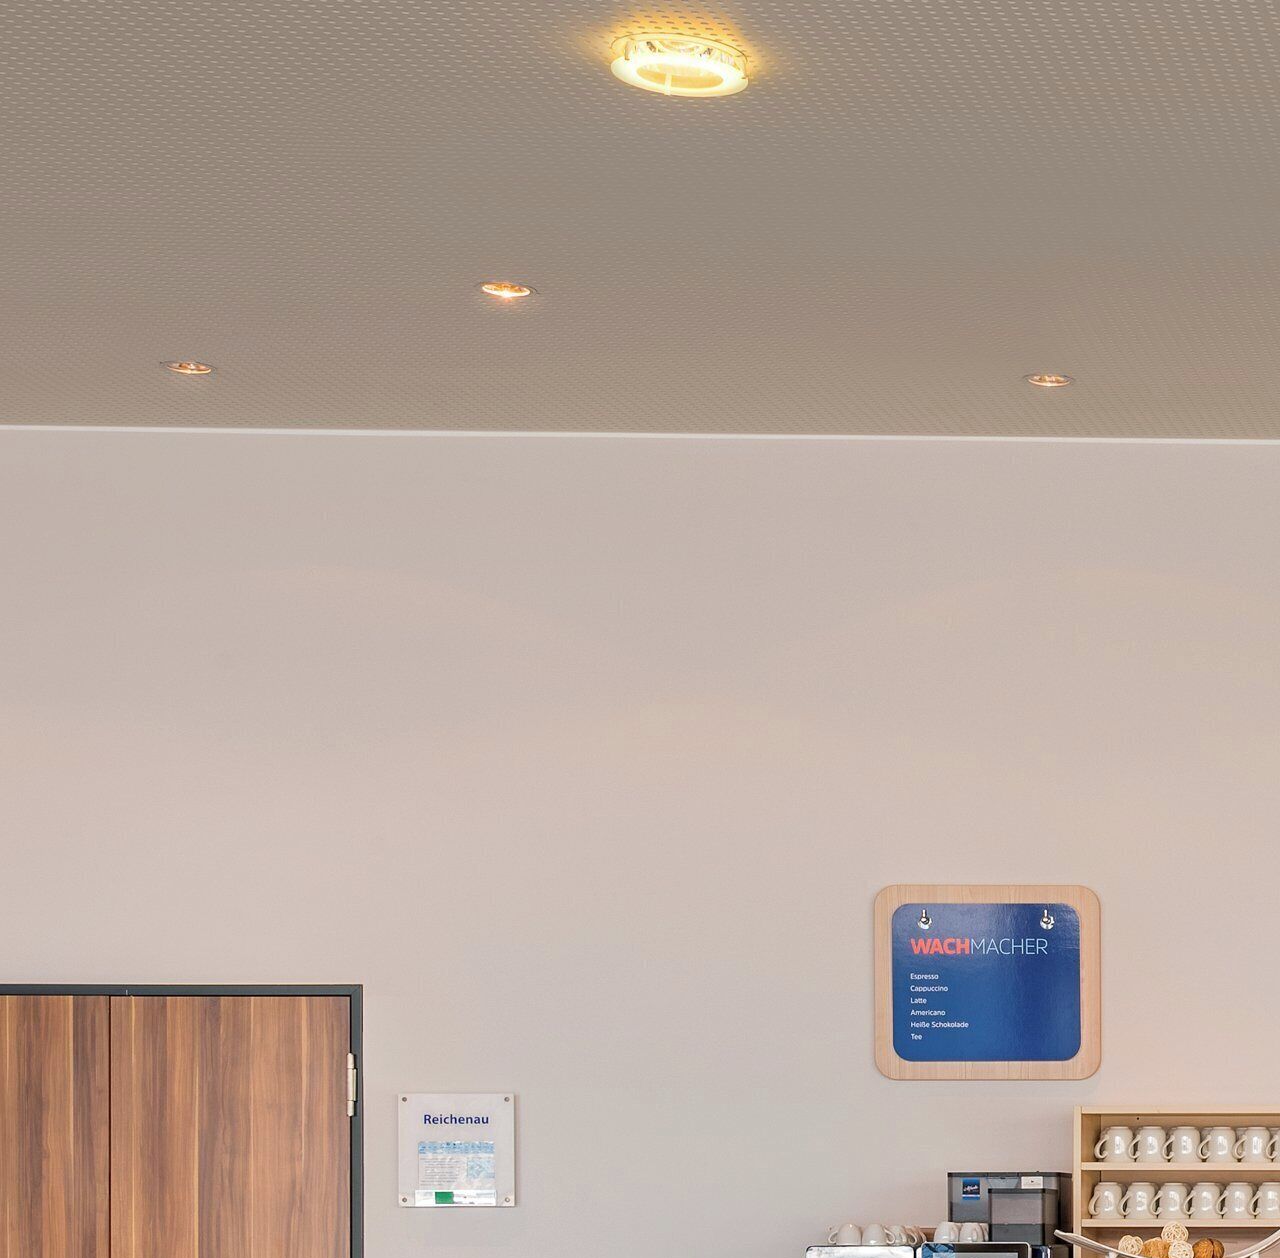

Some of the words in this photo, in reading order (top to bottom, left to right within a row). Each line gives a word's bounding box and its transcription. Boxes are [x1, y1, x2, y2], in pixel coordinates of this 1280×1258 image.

[910, 938, 1048, 955] WACHMACHER
[910, 973, 939, 981] Espresso
[910, 985, 949, 993] Cappuccino
[423, 1114, 489, 1125] Reichenau
